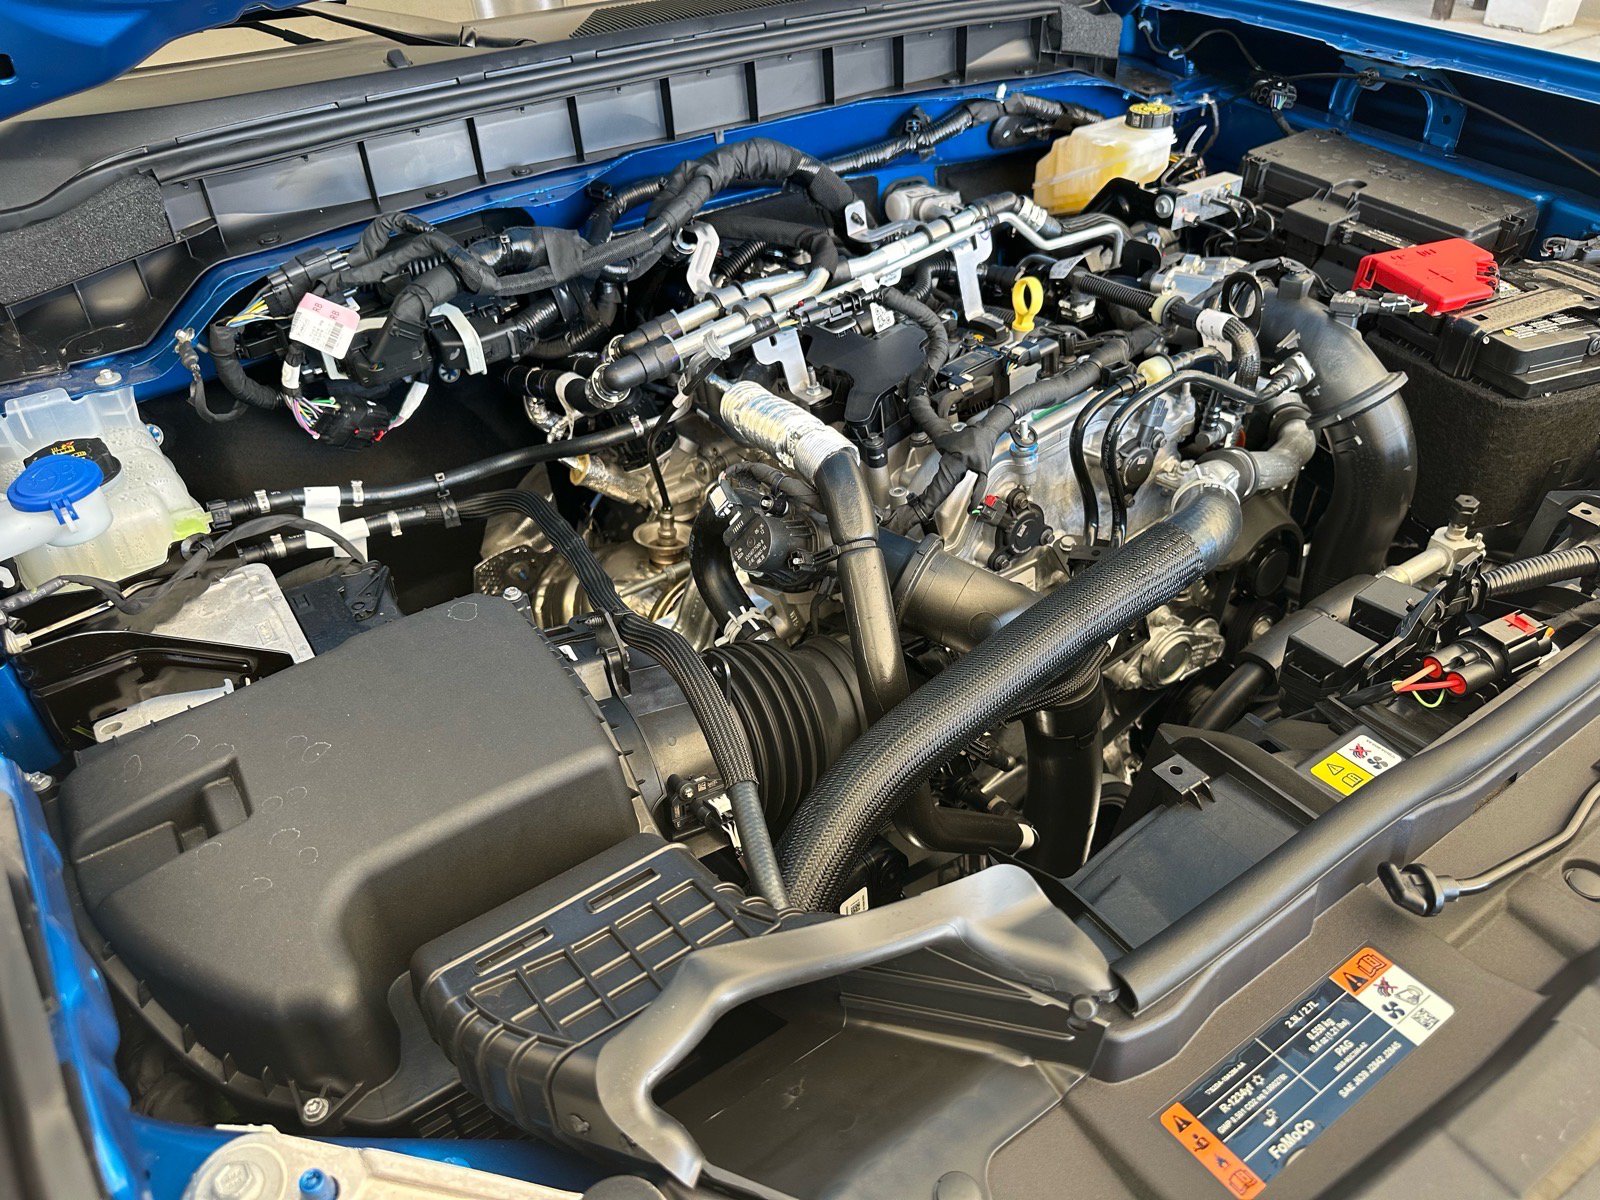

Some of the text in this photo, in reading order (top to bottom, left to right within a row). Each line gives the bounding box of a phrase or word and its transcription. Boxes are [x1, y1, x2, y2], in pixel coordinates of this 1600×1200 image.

[312, 302, 323, 313] RB
[329, 310, 340, 321] RB
[1283, 1012, 1303, 1028] 2.3L
[1300, 998, 1320, 1014] 2.7L
[1305, 1015, 1336, 1041] 0.550 kg
[1333, 1038, 1355, 1056] PAG
[1217, 1081, 1257, 1115] R-1234yf
[1337, 1081, 1356, 1098] SAE
[1215, 1119, 1233, 1135] GWP
[1243, 1097, 1258, 1111] CO2
[1267, 1115, 1317, 1160] FoMoCo
